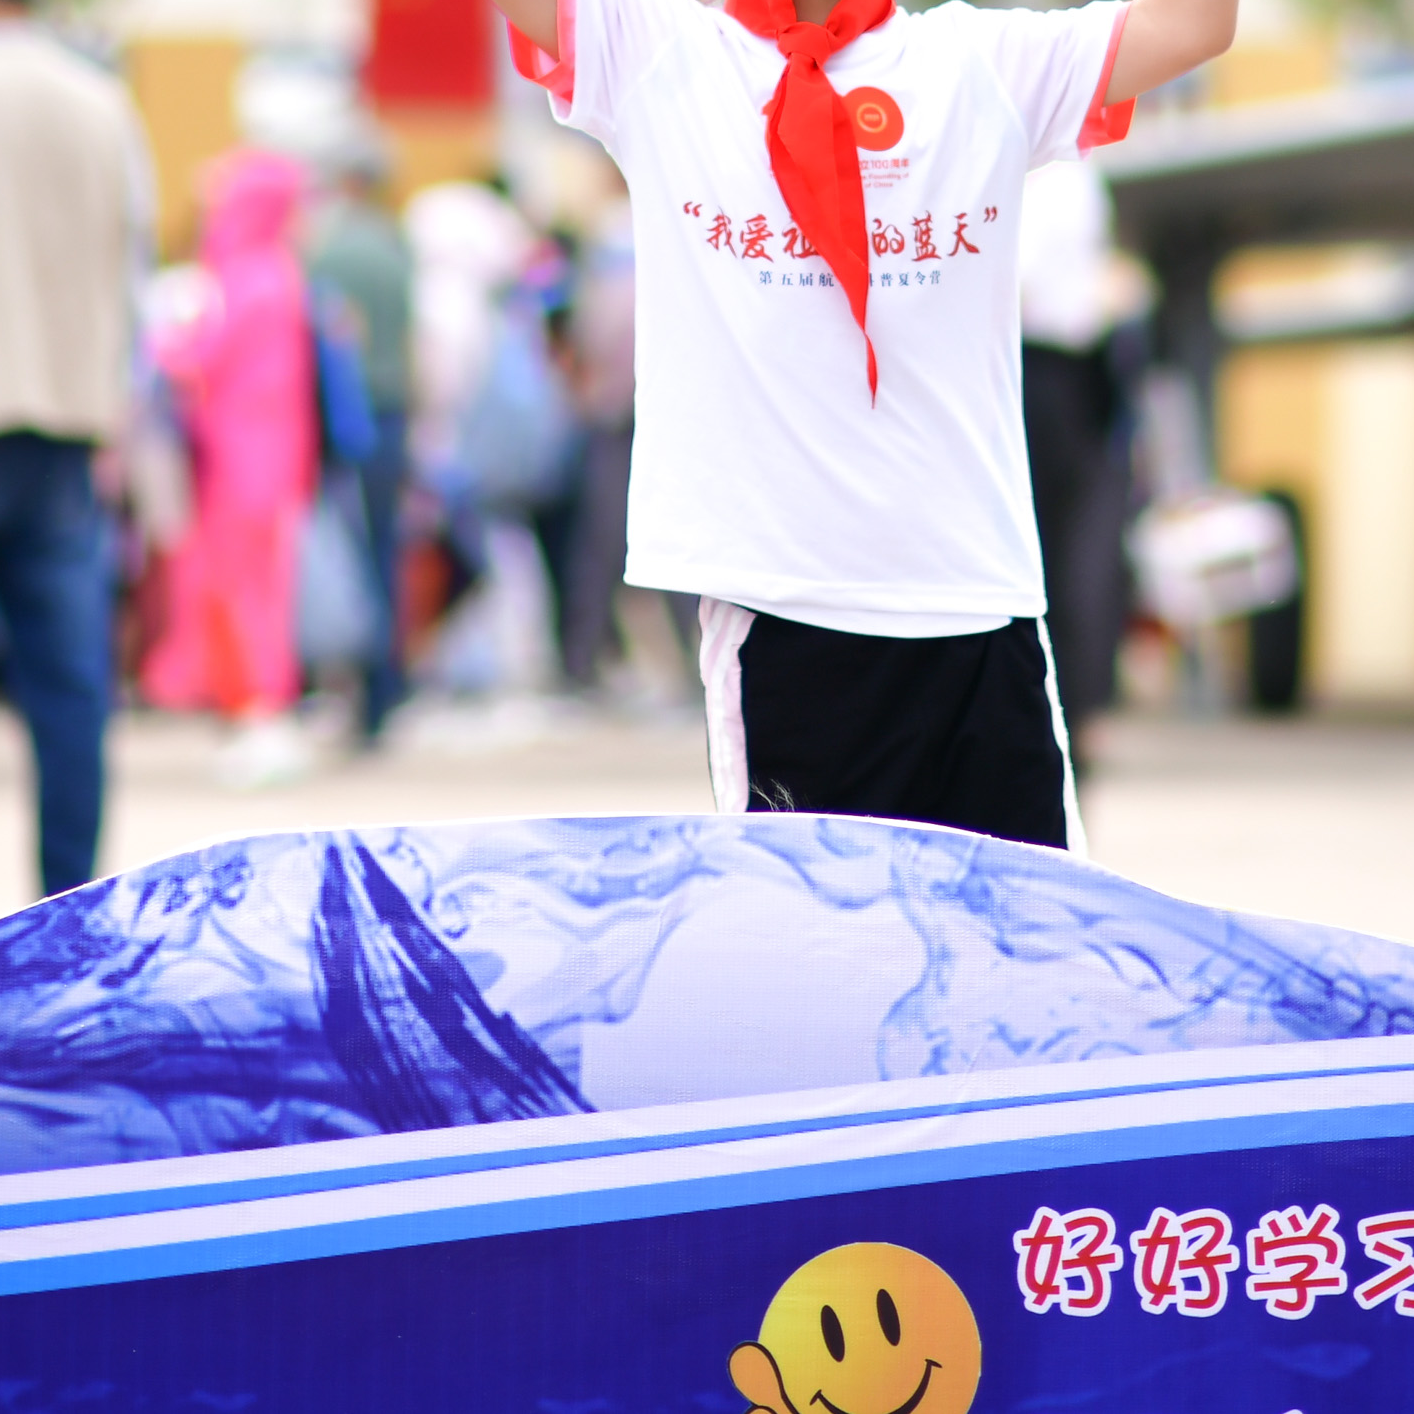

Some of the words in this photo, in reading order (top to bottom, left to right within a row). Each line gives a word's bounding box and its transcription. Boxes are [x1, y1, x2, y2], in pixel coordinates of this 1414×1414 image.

[683, 201, 998, 263] “我爱祖的蓝天”
[758, 270, 942, 287] 第五届航普夏令营
